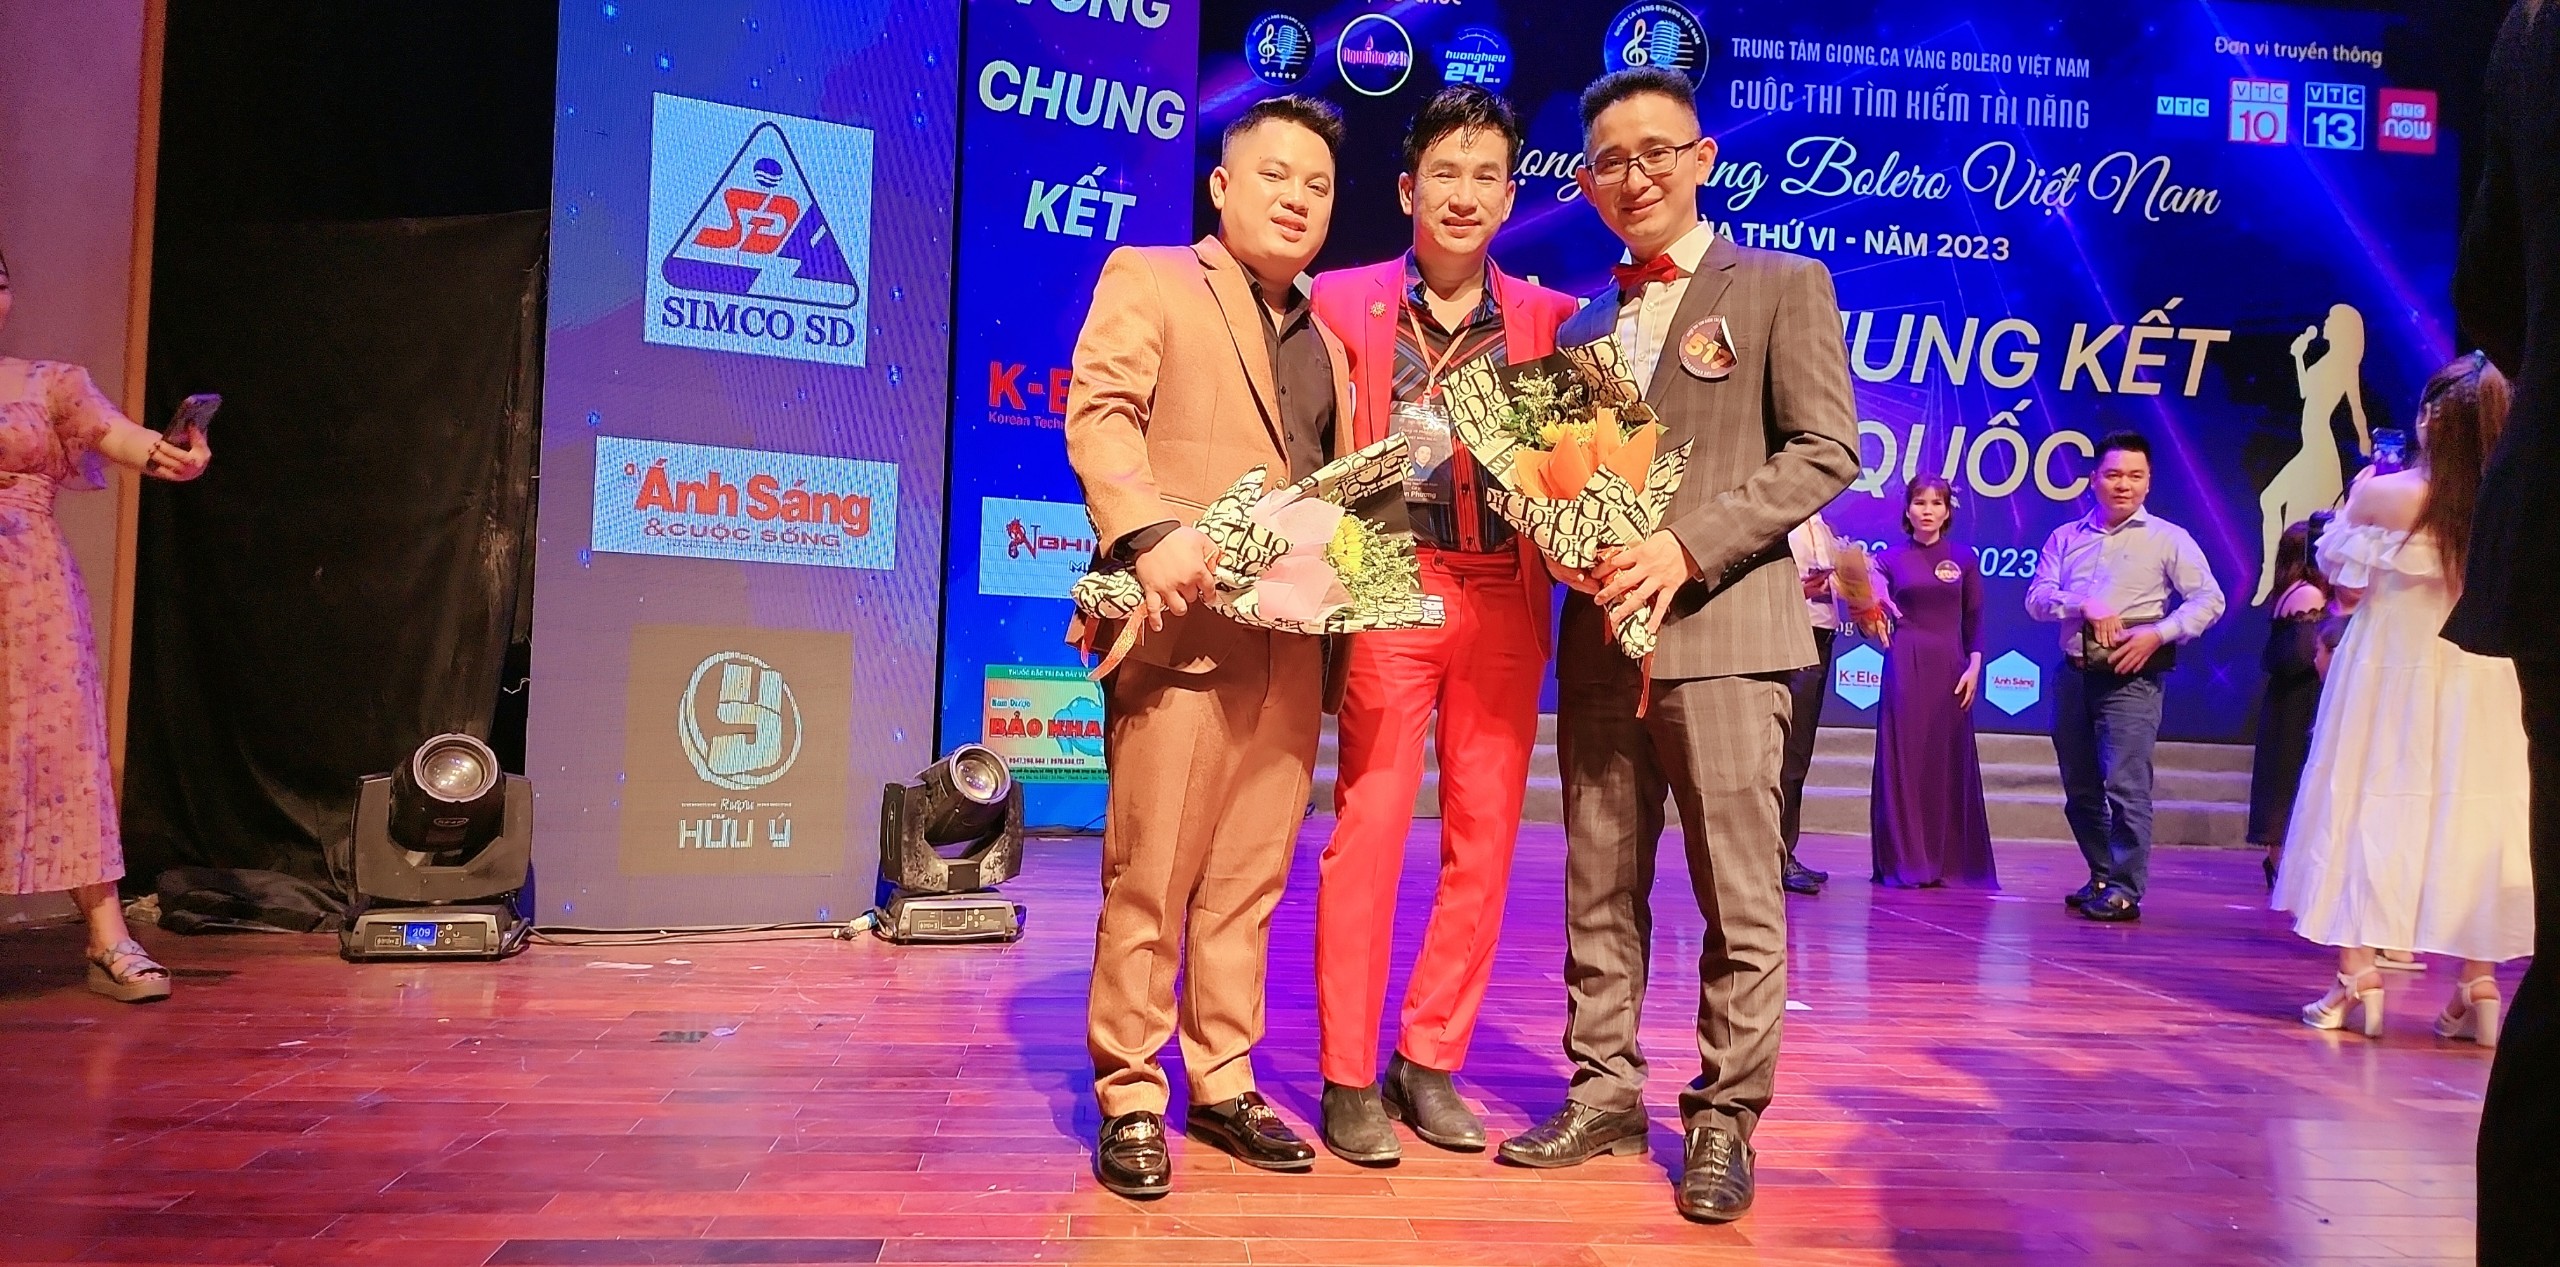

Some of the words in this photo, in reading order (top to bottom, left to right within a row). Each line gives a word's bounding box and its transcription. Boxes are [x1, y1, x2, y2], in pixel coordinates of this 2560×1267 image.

[1732, 38, 1784, 60] TRUNG
[1789, 39, 1820, 62] TÂM
[1880, 48, 1899, 67] CA
[1905, 46, 1946, 70] VÀNG
[1951, 52, 2012, 74] BOLERO
[2017, 54, 2051, 78] VIỆT
[2056, 58, 2090, 78] NAM
[2215, 36, 2249, 56] Đơn
[2254, 40, 2269, 58] vị
[2274, 42, 2328, 63] truyền
[2333, 42, 2383, 69] thông
[978, 60, 1186, 140] CHUNG
[1731, 76, 1794, 116] CUỘC
[1804, 83, 1842, 115] THI
[1852, 81, 1897, 118] TÌM
[1906, 83, 1969, 122] KIẾM
[1980, 87, 2017, 126] TÀI
[2026, 94, 2090, 130] NĂNG
[2158, 97, 2208, 115] VTC
[2235, 84, 2285, 100] VTC
[2309, 86, 2361, 103] VTC
[2239, 110, 2280, 143] 10
[2391, 103, 2425, 118] VTC
[2312, 112, 2357, 149] 13
[1781, 136, 1951, 200] Bolero
[1962, 141, 2080, 216] Việt
[2087, 151, 2221, 222] Nam
[1024, 166, 1137, 241] KẾT
[1741, 218, 1805, 250] THỨ
[1807, 226, 1836, 252] VI
[1864, 225, 1928, 257] NĂM
[1936, 233, 2010, 261] 2023
[661, 297, 794, 341] SIMCO
[805, 314, 855, 348] SD
[1843, 310, 2040, 389] UNG
[2059, 297, 2231, 397] KẾT
[988, 361, 1072, 414] K-E
[988, 411, 1030, 427] Korean
[1033, 415, 1066, 430] Techn
[1853, 399, 2096, 501] QUỐC
[635, 458, 739, 518] Ánh
[747, 474, 870, 538] Sáng
[761, 526, 841, 547] SỐNG
[1971, 546, 2038, 578] 023
[1839, 670, 1880, 683] K-Ele
[989, 711, 1043, 738] BẢO
[1047, 718, 1104, 739] KHA
[679, 814, 753, 848] HỮU
[412, 927, 431, 937] 209
